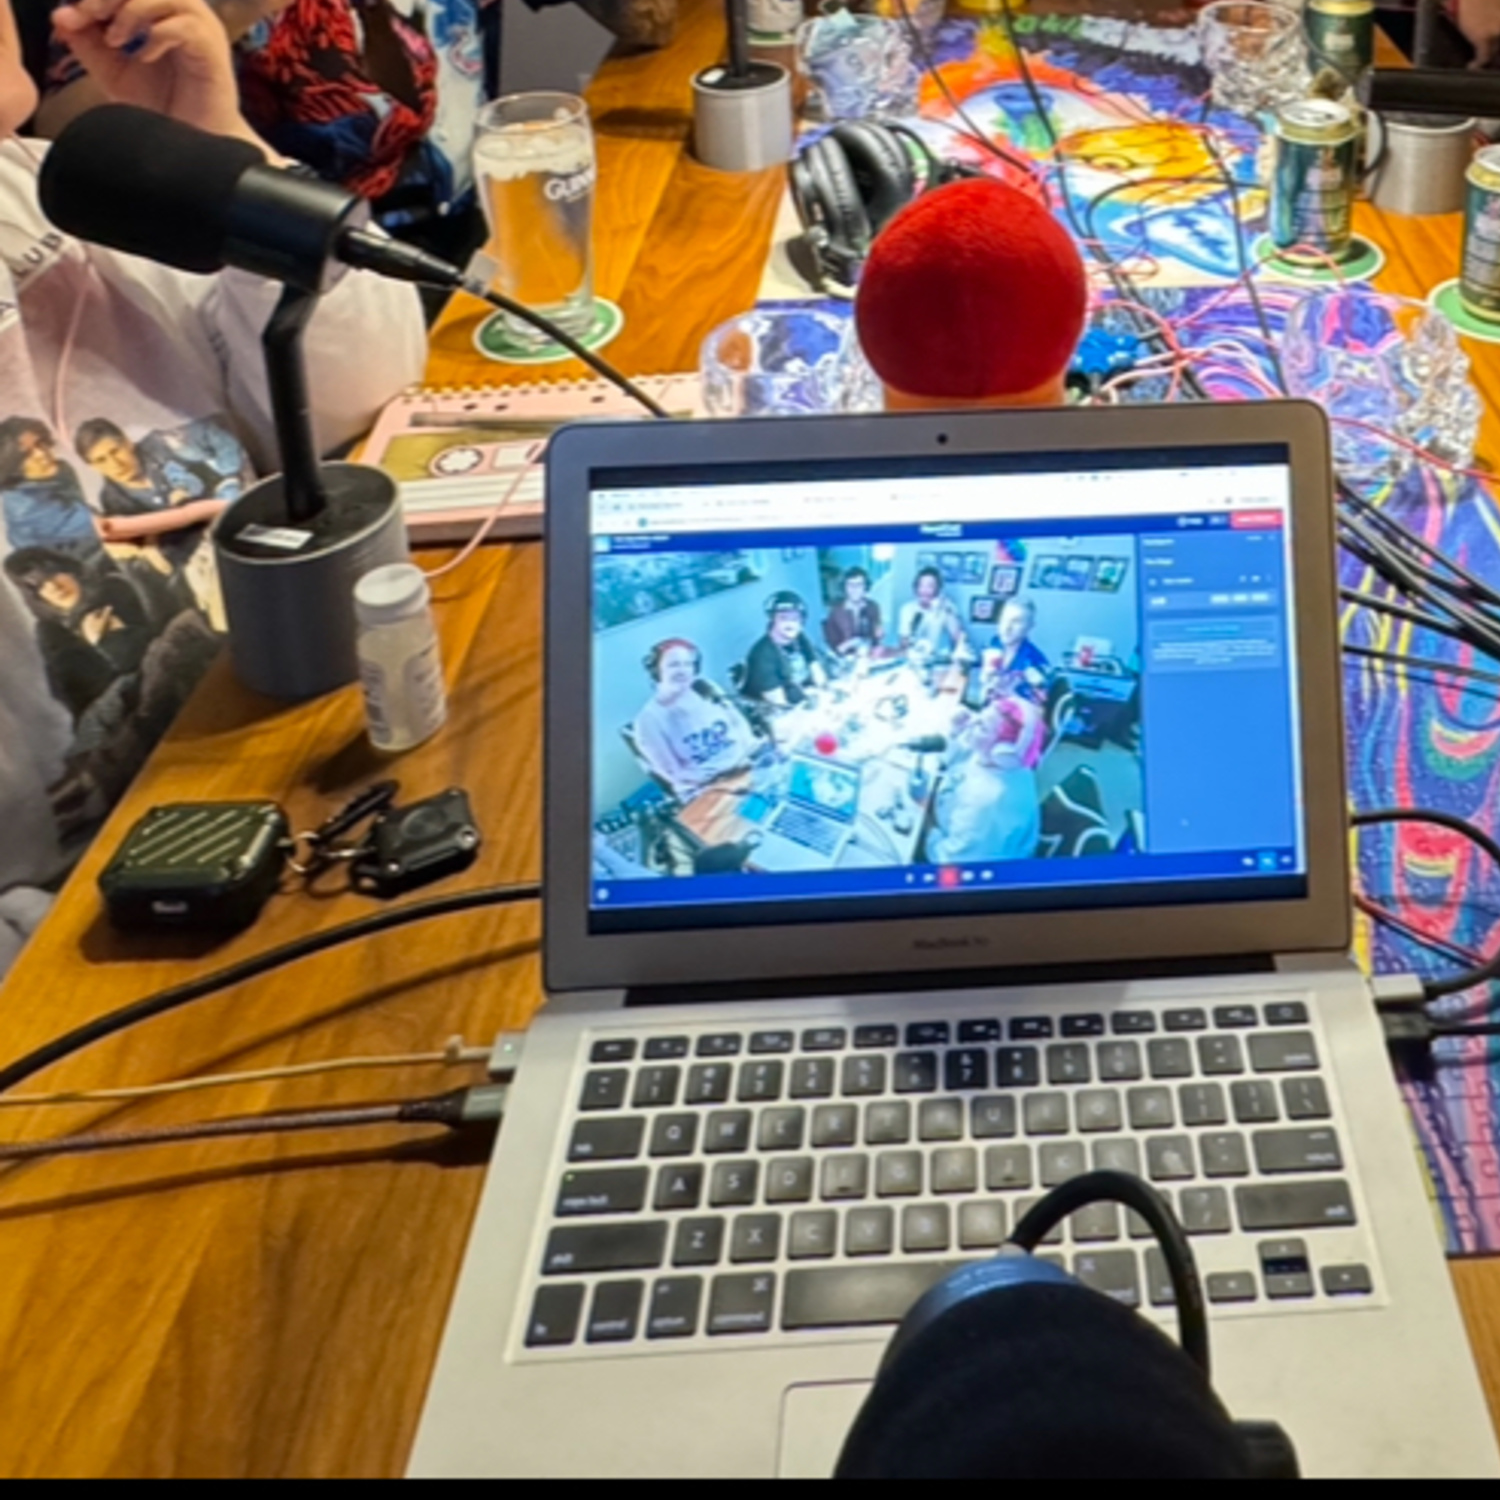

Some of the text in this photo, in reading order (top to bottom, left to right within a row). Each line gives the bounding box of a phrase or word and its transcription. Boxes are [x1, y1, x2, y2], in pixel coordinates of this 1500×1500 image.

[666, 1125, 682, 1140] Q
[986, 1107, 1001, 1123] U
[671, 1176, 686, 1192] A
[727, 1173, 740, 1190] S
[782, 1170, 796, 1186] D
[691, 1230, 704, 1248] Z
[748, 1228, 762, 1244] X
